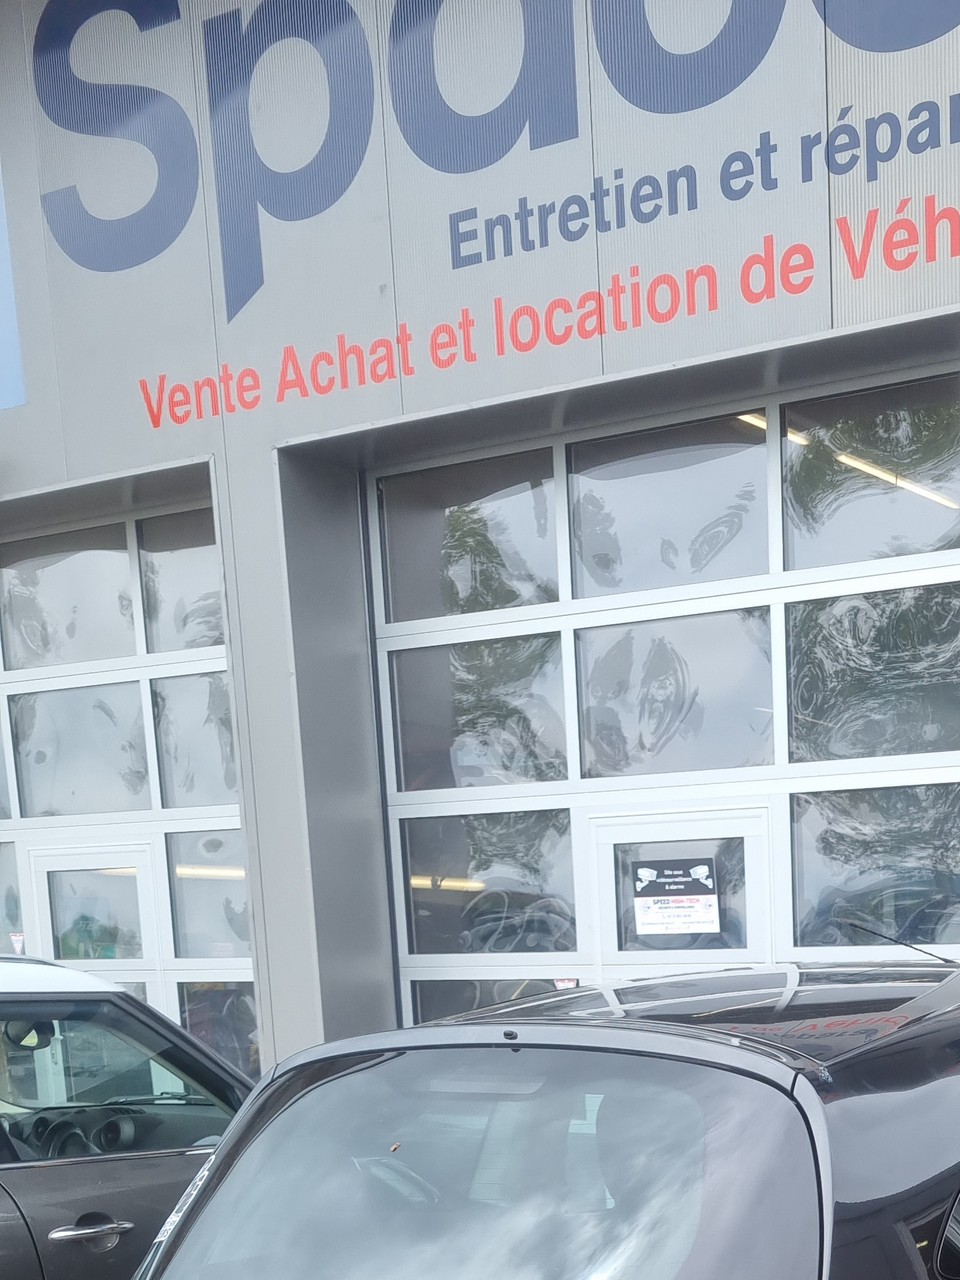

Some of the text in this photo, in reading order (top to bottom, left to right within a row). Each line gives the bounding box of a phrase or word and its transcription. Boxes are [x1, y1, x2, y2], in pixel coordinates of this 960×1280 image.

[450, 166, 698, 269] Entretien
[719, 133, 778, 200] et
[140, 365, 260, 429] Vente
[277, 323, 413, 403] Achat
[430, 308, 478, 369] et
[495, 264, 718, 357] location
[740, 235, 815, 304] de
